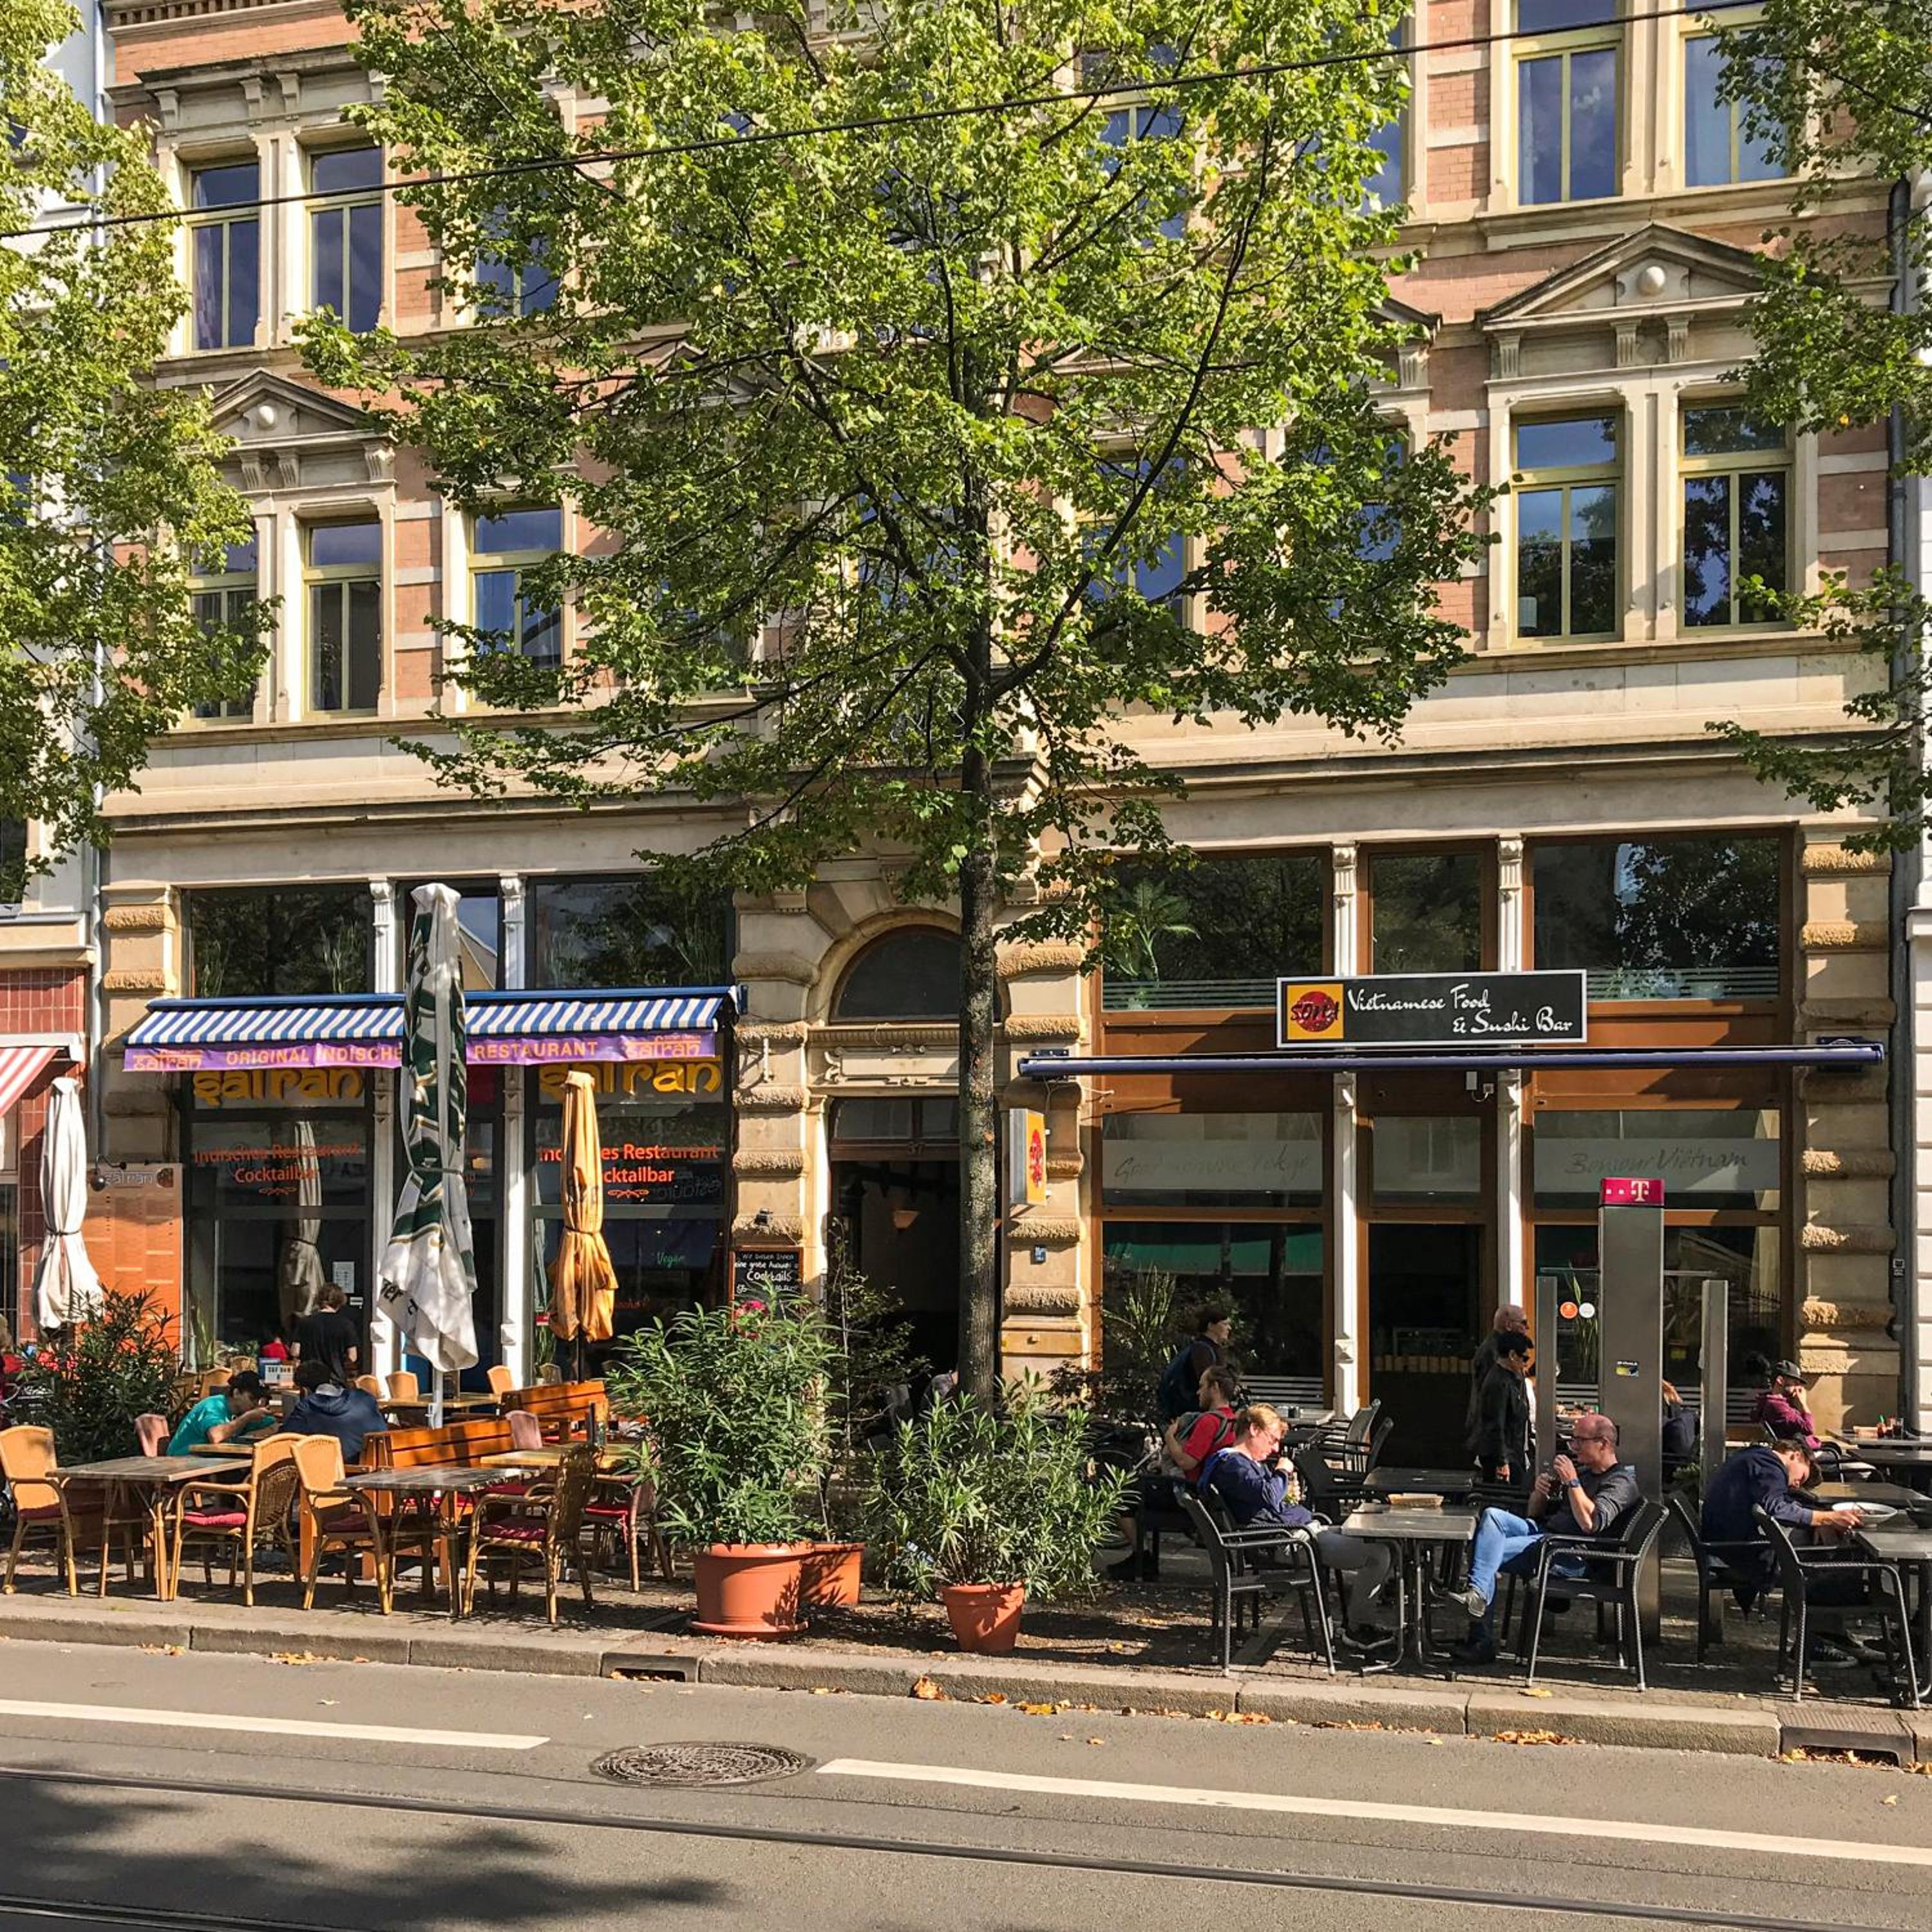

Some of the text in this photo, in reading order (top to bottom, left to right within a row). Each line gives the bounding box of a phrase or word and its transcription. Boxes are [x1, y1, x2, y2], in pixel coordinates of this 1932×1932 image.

[1347, 983, 1490, 1011] Vietnamese Food
[1452, 1006, 1573, 1034] & Sushi Bar
[227, 1051, 310, 1065] ORIGINAL
[474, 1041, 598, 1059] RESTAURANT
[623, 1144, 719, 1160] Restaurant
[603, 1166, 675, 1183] cktailbar
[1631, 1180, 1649, 1202] T
